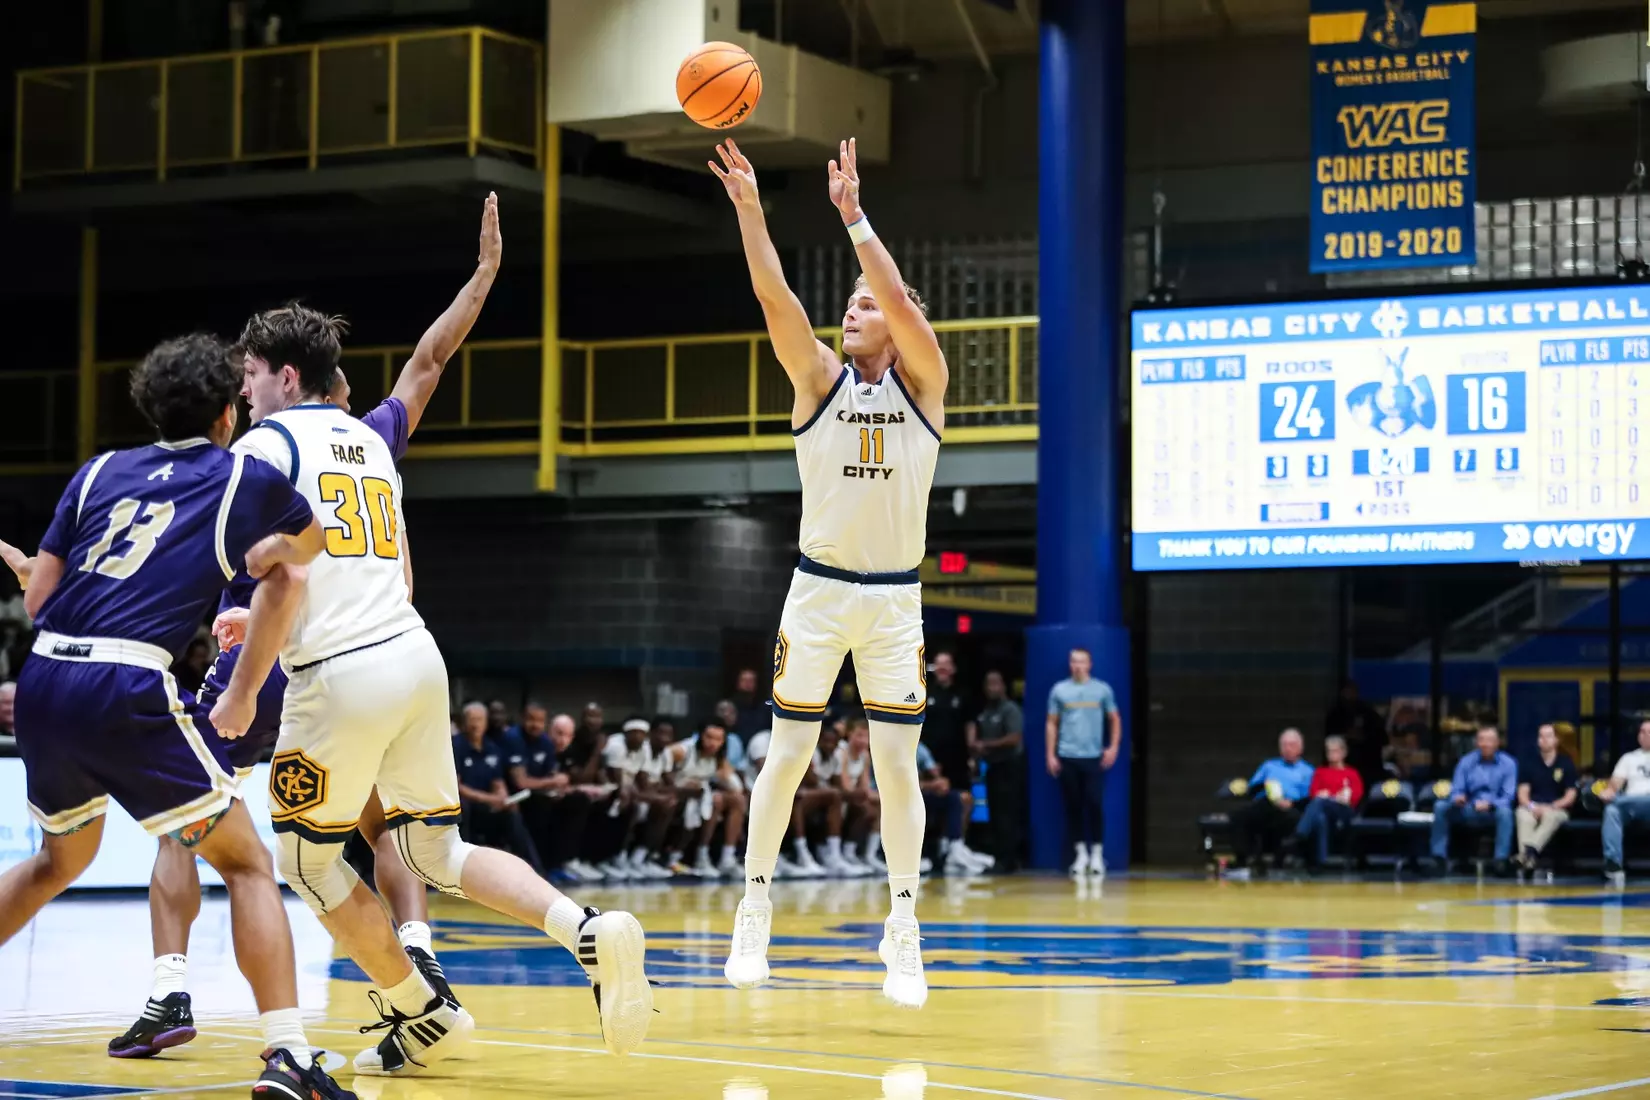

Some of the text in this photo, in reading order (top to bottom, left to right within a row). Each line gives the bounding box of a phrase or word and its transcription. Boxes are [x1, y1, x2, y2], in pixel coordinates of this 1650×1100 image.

[1316, 50, 1470, 73] KANSAS CITY
[1335, 68, 1450, 86] WOMEN'S BASKETBALL
[1337, 99, 1450, 148] WAC
[1316, 148, 1470, 183] CONFERENCE
[1322, 180, 1464, 214] CHAMPIONS
[1324, 226, 1462, 260] 2019-2020
[1142, 311, 1362, 343] KANSAS CITY
[1418, 297, 1648, 329] BASKETBALL
[1541, 338, 1649, 362] PLYR FLS PTS
[1266, 359, 1333, 375] ROOS
[836, 410, 905, 424] KANSAS
[1274, 385, 1325, 439] 24
[1462, 377, 1508, 431] 16
[860, 427, 884, 464] 11
[1590, 428, 1600, 448] 0
[1628, 426, 1638, 447] 0
[330, 444, 366, 465] FAAS
[843, 465, 894, 480] CITY
[1375, 480, 1405, 498] 1ST
[1590, 485, 1600, 504] 0
[1628, 483, 1639, 504] 0
[318, 472, 399, 560] 30
[78, 497, 175, 580] 13
[1158, 537, 1212, 557] THANK
[1214, 537, 1247, 556] YOU
[1248, 536, 1270, 555] TO
[1272, 535, 1306, 555] OUR
[1533, 522, 1636, 555] evergy
